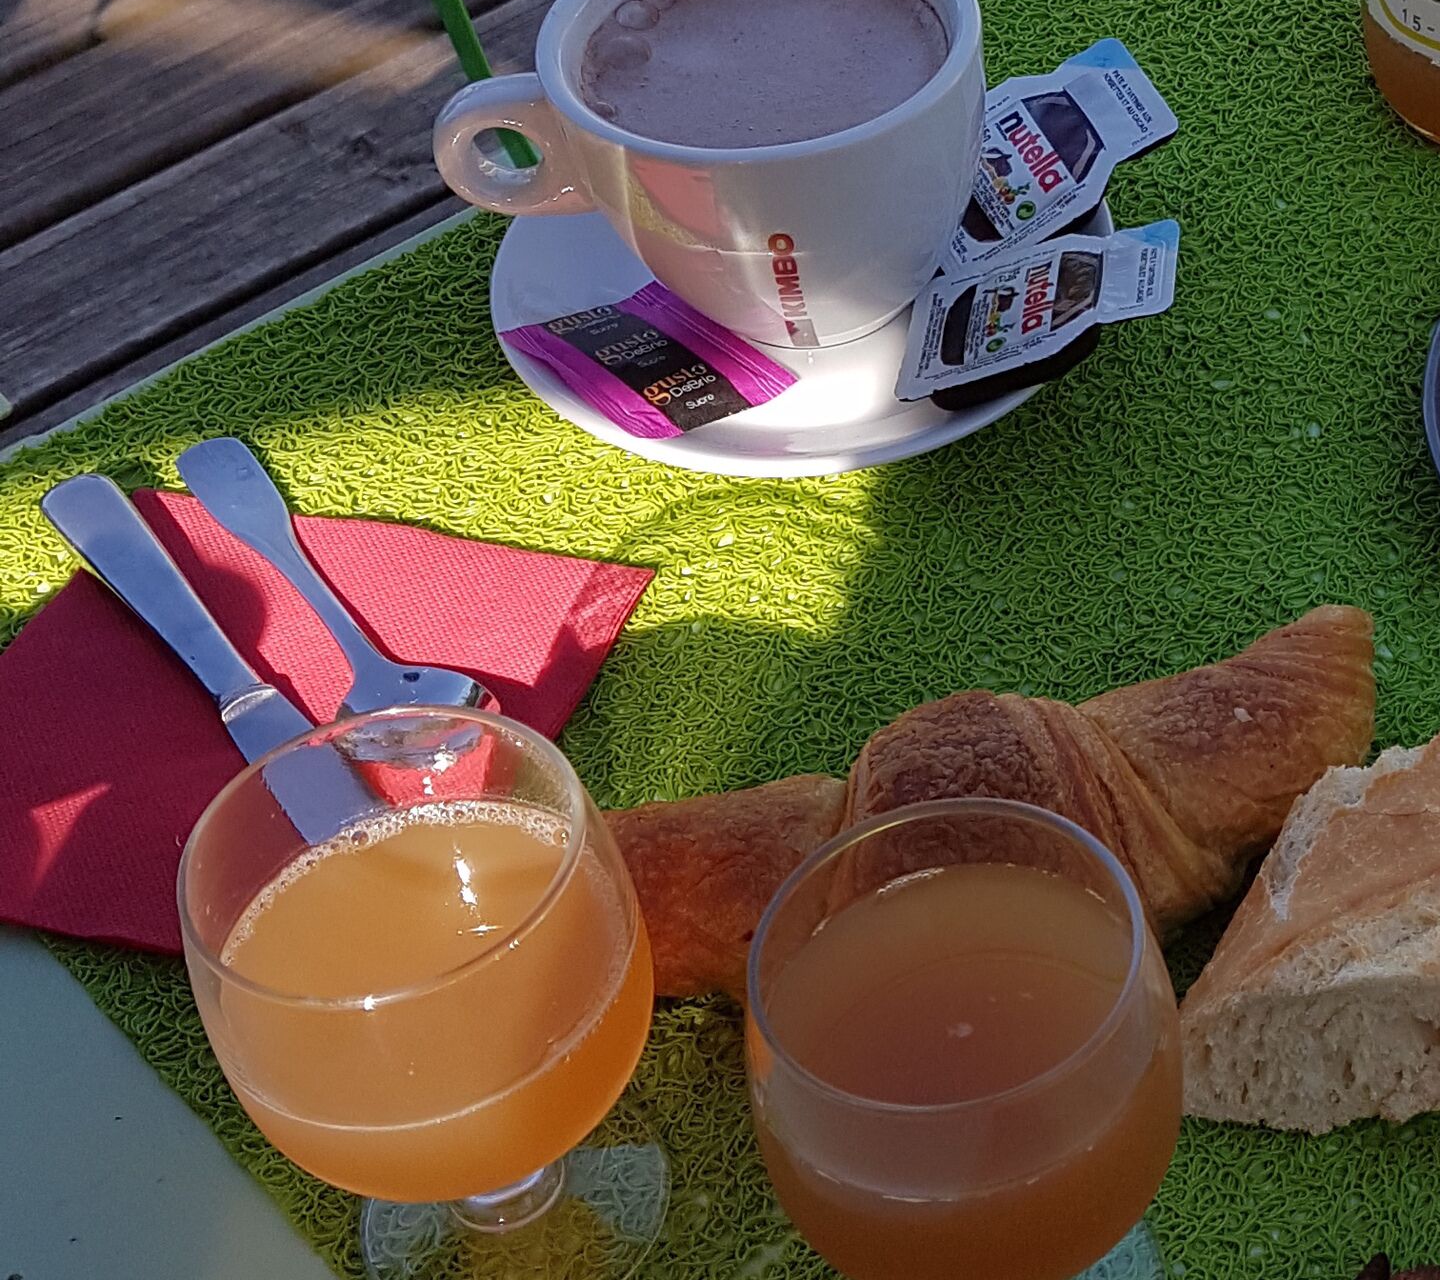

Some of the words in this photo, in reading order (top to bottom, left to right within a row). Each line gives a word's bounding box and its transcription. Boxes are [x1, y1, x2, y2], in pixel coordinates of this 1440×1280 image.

[1131, 113, 1149, 133] CACAO
[1000, 111, 1065, 193] nutella
[767, 232, 808, 318] KIMBO
[1021, 260, 1055, 336] nutella
[595, 329, 660, 365] gusto
[620, 339, 669, 360] DeBrio
[643, 363, 707, 406] gusto
[669, 375, 716, 398] DeBrio
[685, 393, 715, 410] Sucre
